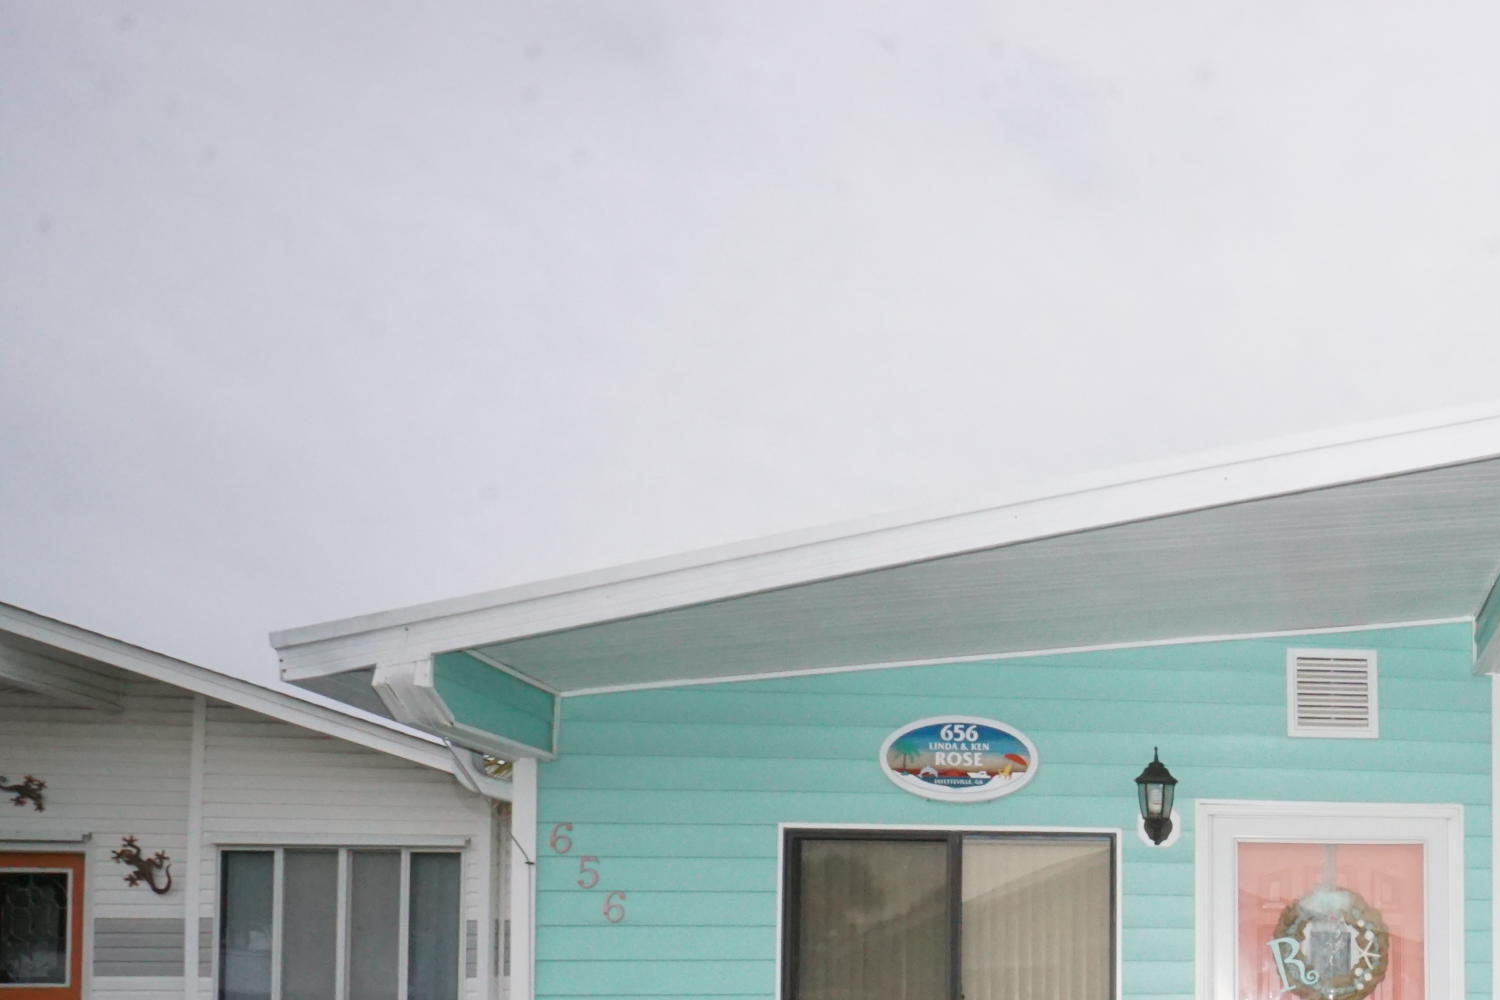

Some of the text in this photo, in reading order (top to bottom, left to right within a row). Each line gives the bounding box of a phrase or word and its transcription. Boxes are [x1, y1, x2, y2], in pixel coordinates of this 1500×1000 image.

[940, 724, 979, 742] 656
[929, 742, 990, 751] LINDA & KEN
[935, 751, 983, 766] ROSE
[1266, 937, 1320, 993] R
